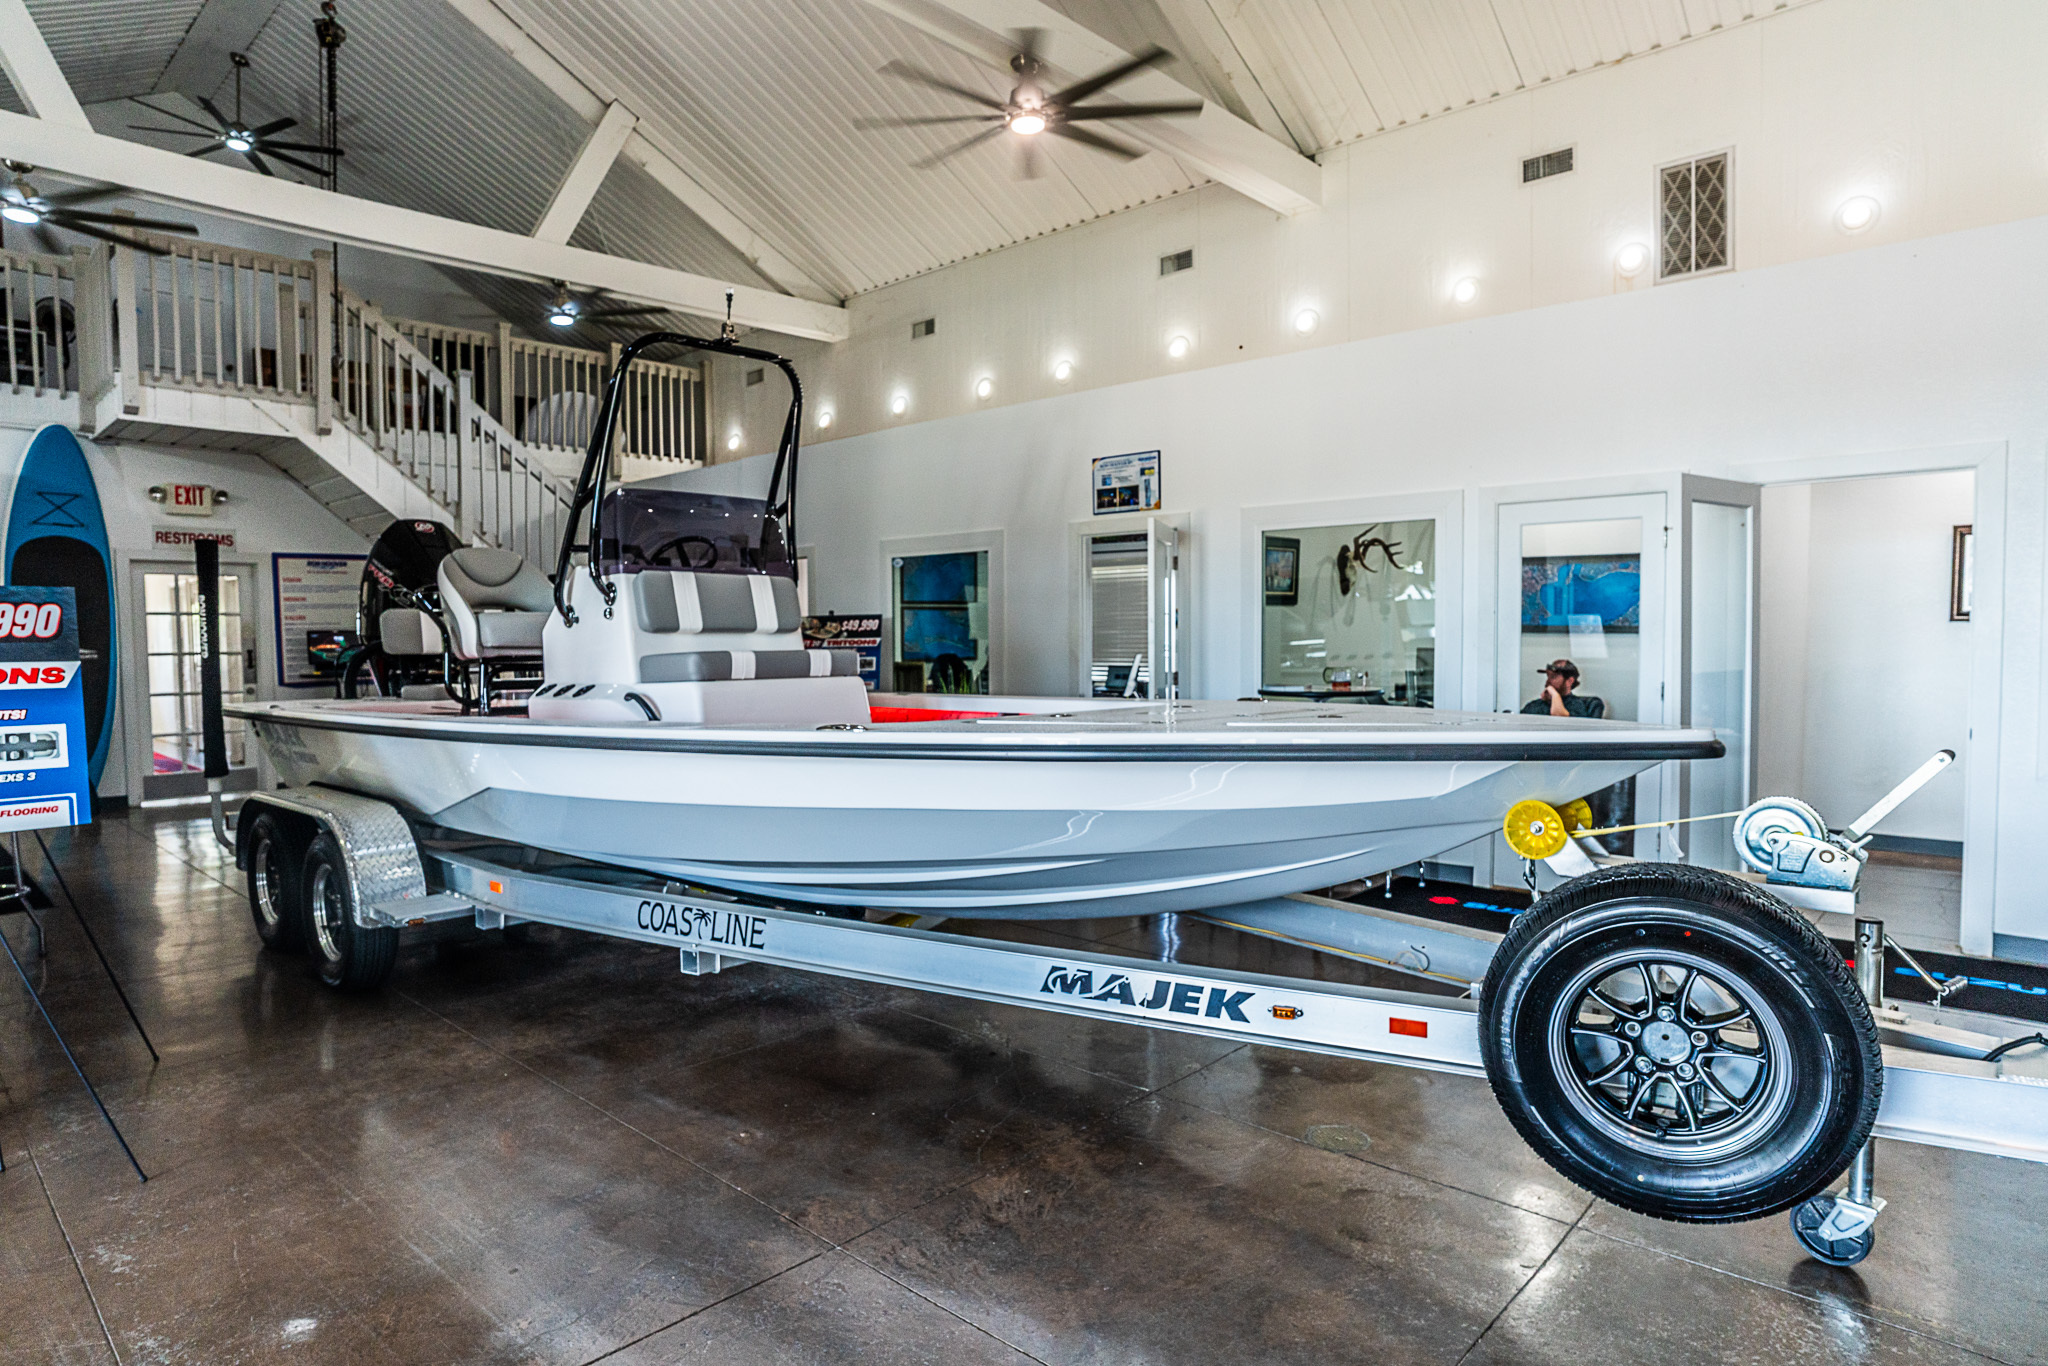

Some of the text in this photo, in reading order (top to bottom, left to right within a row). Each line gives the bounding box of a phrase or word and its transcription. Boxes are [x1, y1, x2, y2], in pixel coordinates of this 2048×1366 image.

[174, 485, 205, 506] EXIT
[0, 666, 65, 684] NS
[27, 772, 36, 781] 3
[0, 806, 59, 818] FLOORING
[1040, 965, 1256, 1024] MAJEK
